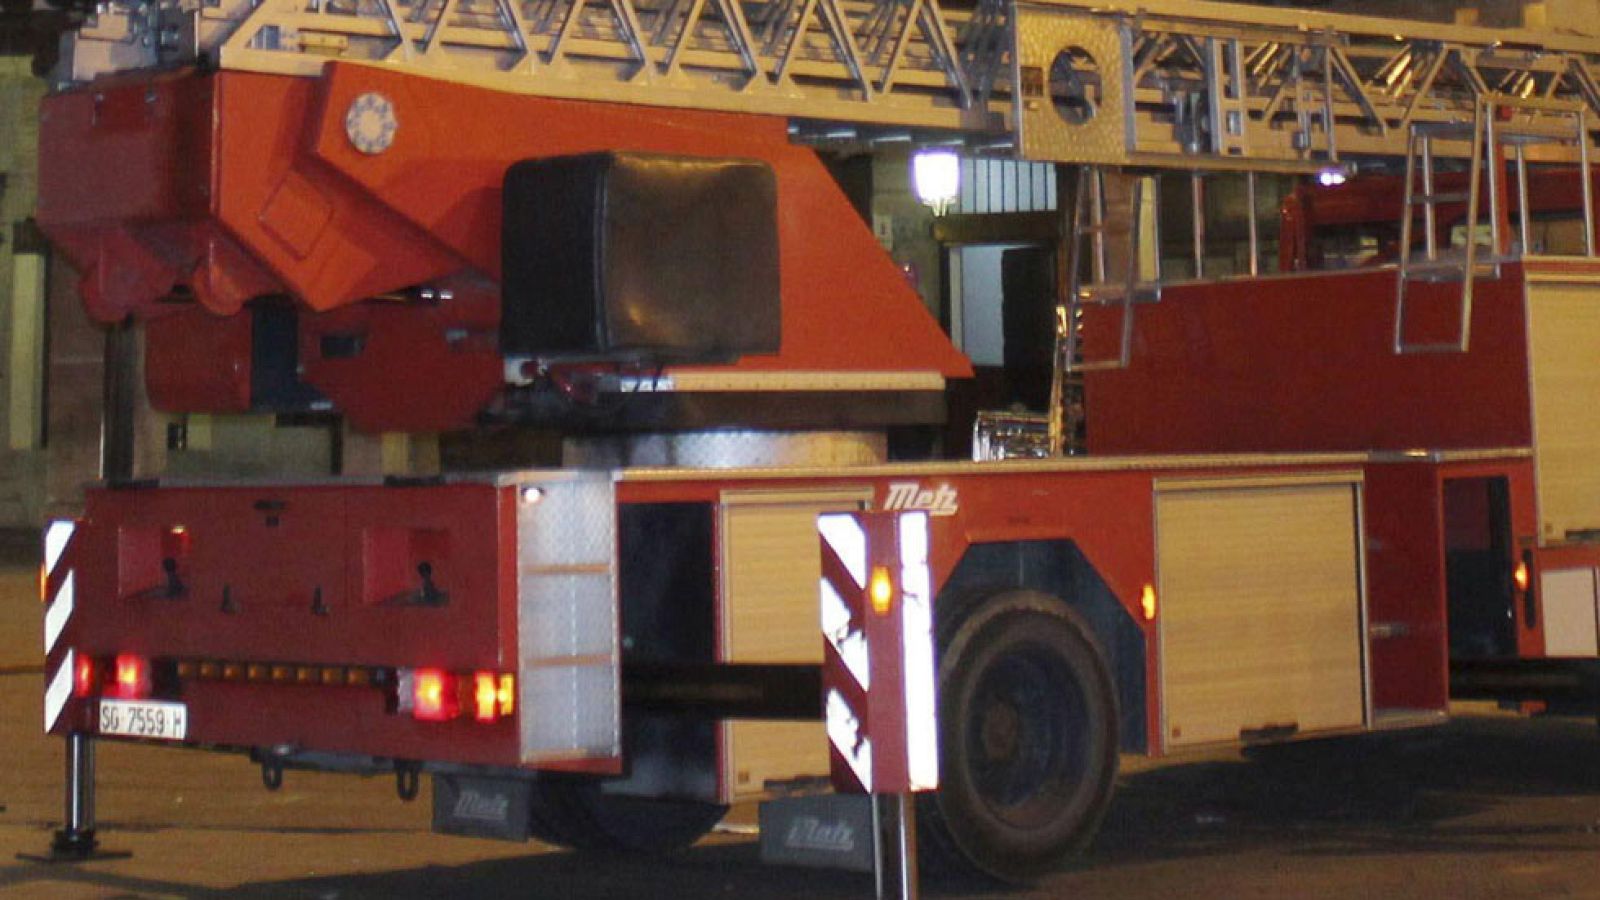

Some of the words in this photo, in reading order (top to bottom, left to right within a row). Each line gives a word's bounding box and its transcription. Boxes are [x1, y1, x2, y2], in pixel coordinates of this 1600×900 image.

[884, 482, 958, 516] Metz
[102, 705, 120, 731] SG
[128, 706, 166, 735] 7559
[172, 710, 182, 738] H
